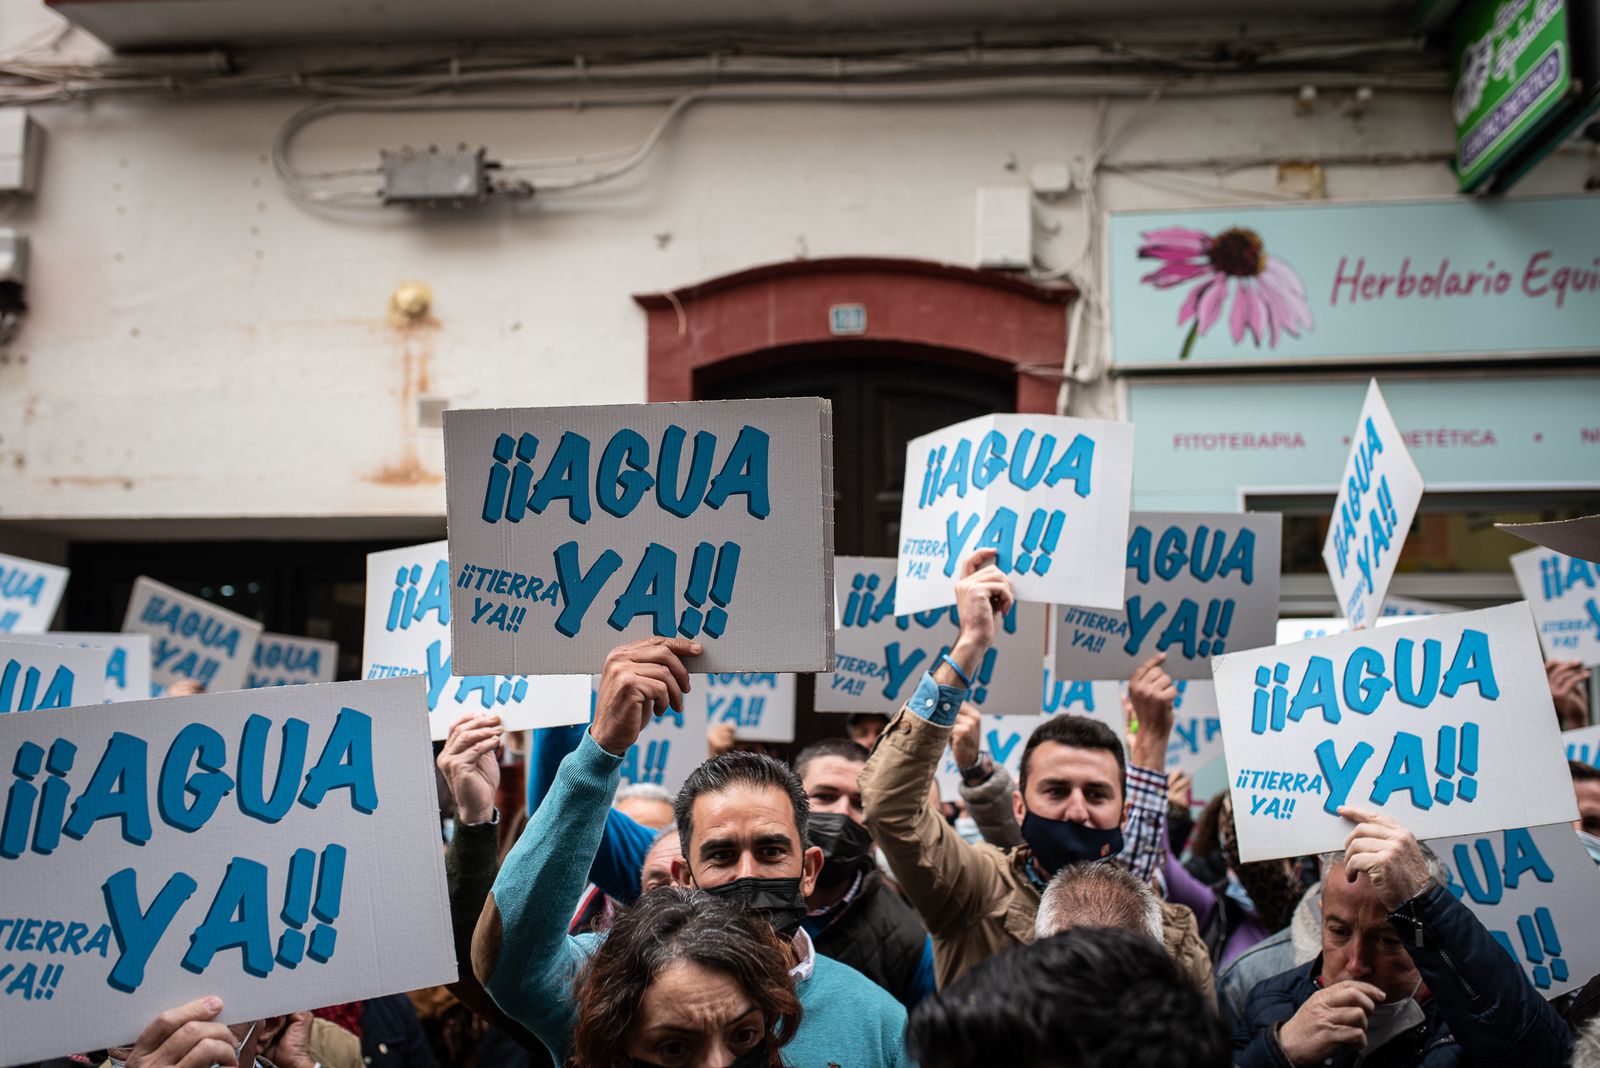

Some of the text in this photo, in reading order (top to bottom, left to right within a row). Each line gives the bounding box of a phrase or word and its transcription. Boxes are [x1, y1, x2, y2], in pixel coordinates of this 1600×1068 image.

[1330, 255, 1513, 307] Herbolario
[1172, 431, 1306, 450] FITOTERAPIA
[1401, 426, 1498, 448] IETÉTICA
[481, 424, 771, 525] ¡¡AGUA
[918, 428, 1095, 509] ¡¡AGUA
[943, 506, 1066, 577] YA!!
[1126, 525, 1256, 585] AGUA
[457, 563, 561, 606] ¡¡TIERRA
[552, 540, 741, 639] YA!!
[470, 597, 527, 634] YA!!
[1064, 608, 1128, 638] ¡¡TIERRA
[1071, 630, 1106, 654] YA!!
[1124, 595, 1235, 660] YA!!
[831, 672, 866, 697] YA!!
[1251, 629, 1500, 735] ¡¡AGUA
[0, 707, 378, 859] ¡¡AGUA
[1235, 769, 1322, 796] ¡¡TIERRA
[1314, 722, 1479, 817] YA!!
[1250, 795, 1296, 820] YA!!
[101, 843, 347, 993] YA!!
